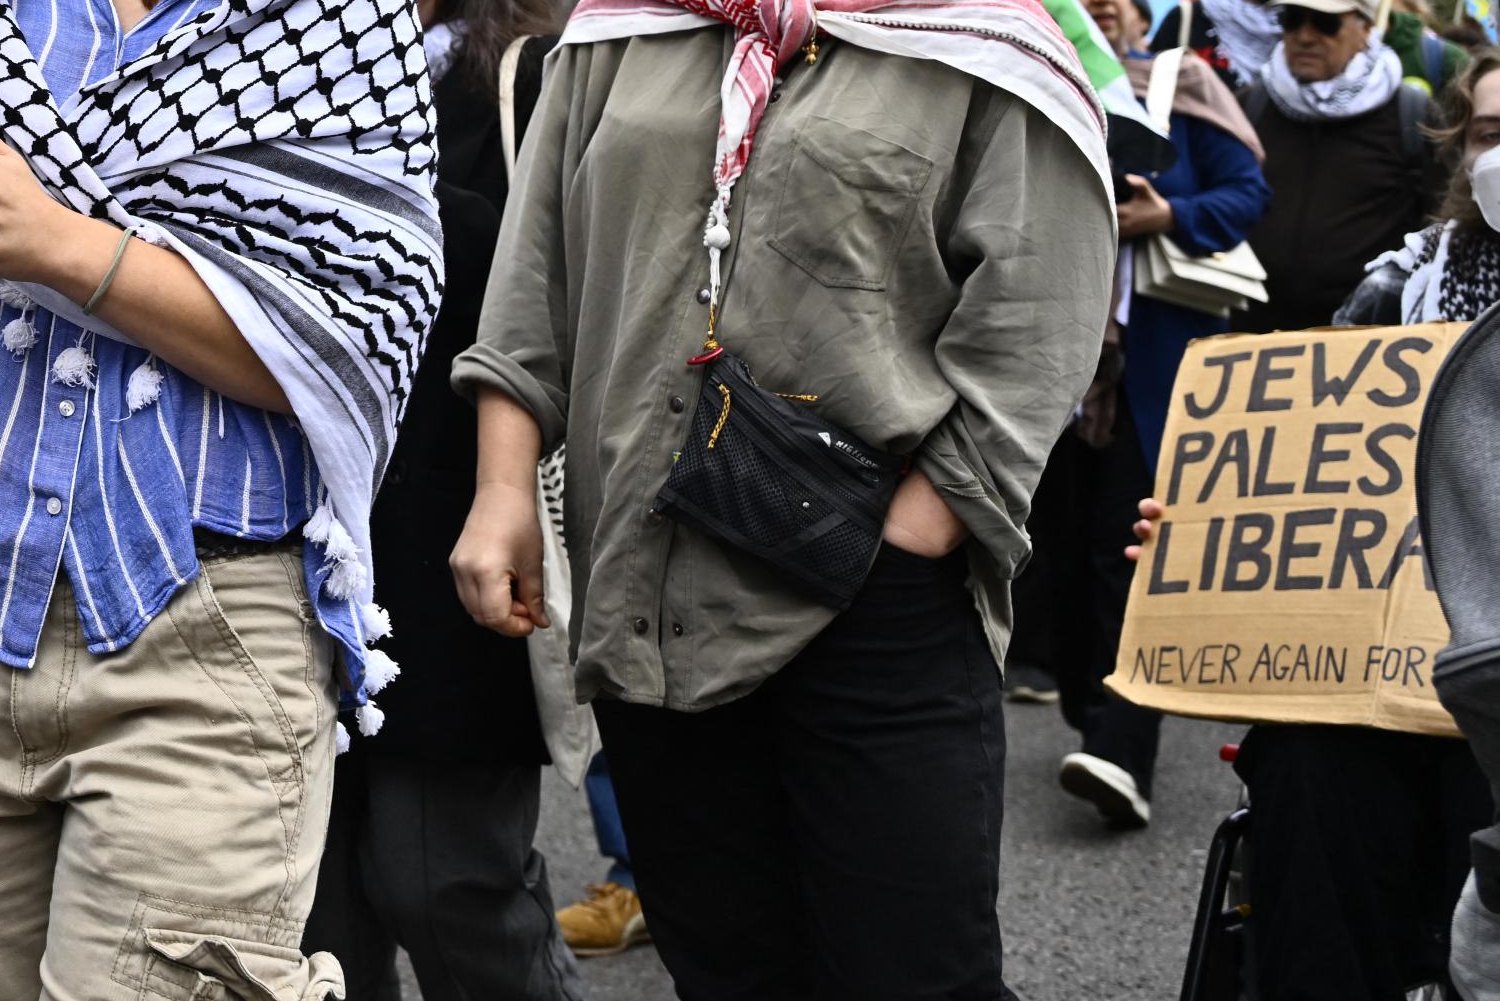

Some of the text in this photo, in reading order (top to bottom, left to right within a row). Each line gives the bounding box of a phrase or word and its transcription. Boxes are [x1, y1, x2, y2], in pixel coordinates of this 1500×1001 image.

[1184, 337, 1434, 419] JEWS
[1166, 422, 1417, 507] PALES
[1147, 508, 1437, 596] LIBERA
[1130, 644, 1427, 687] NEVER AGAIN FOR
